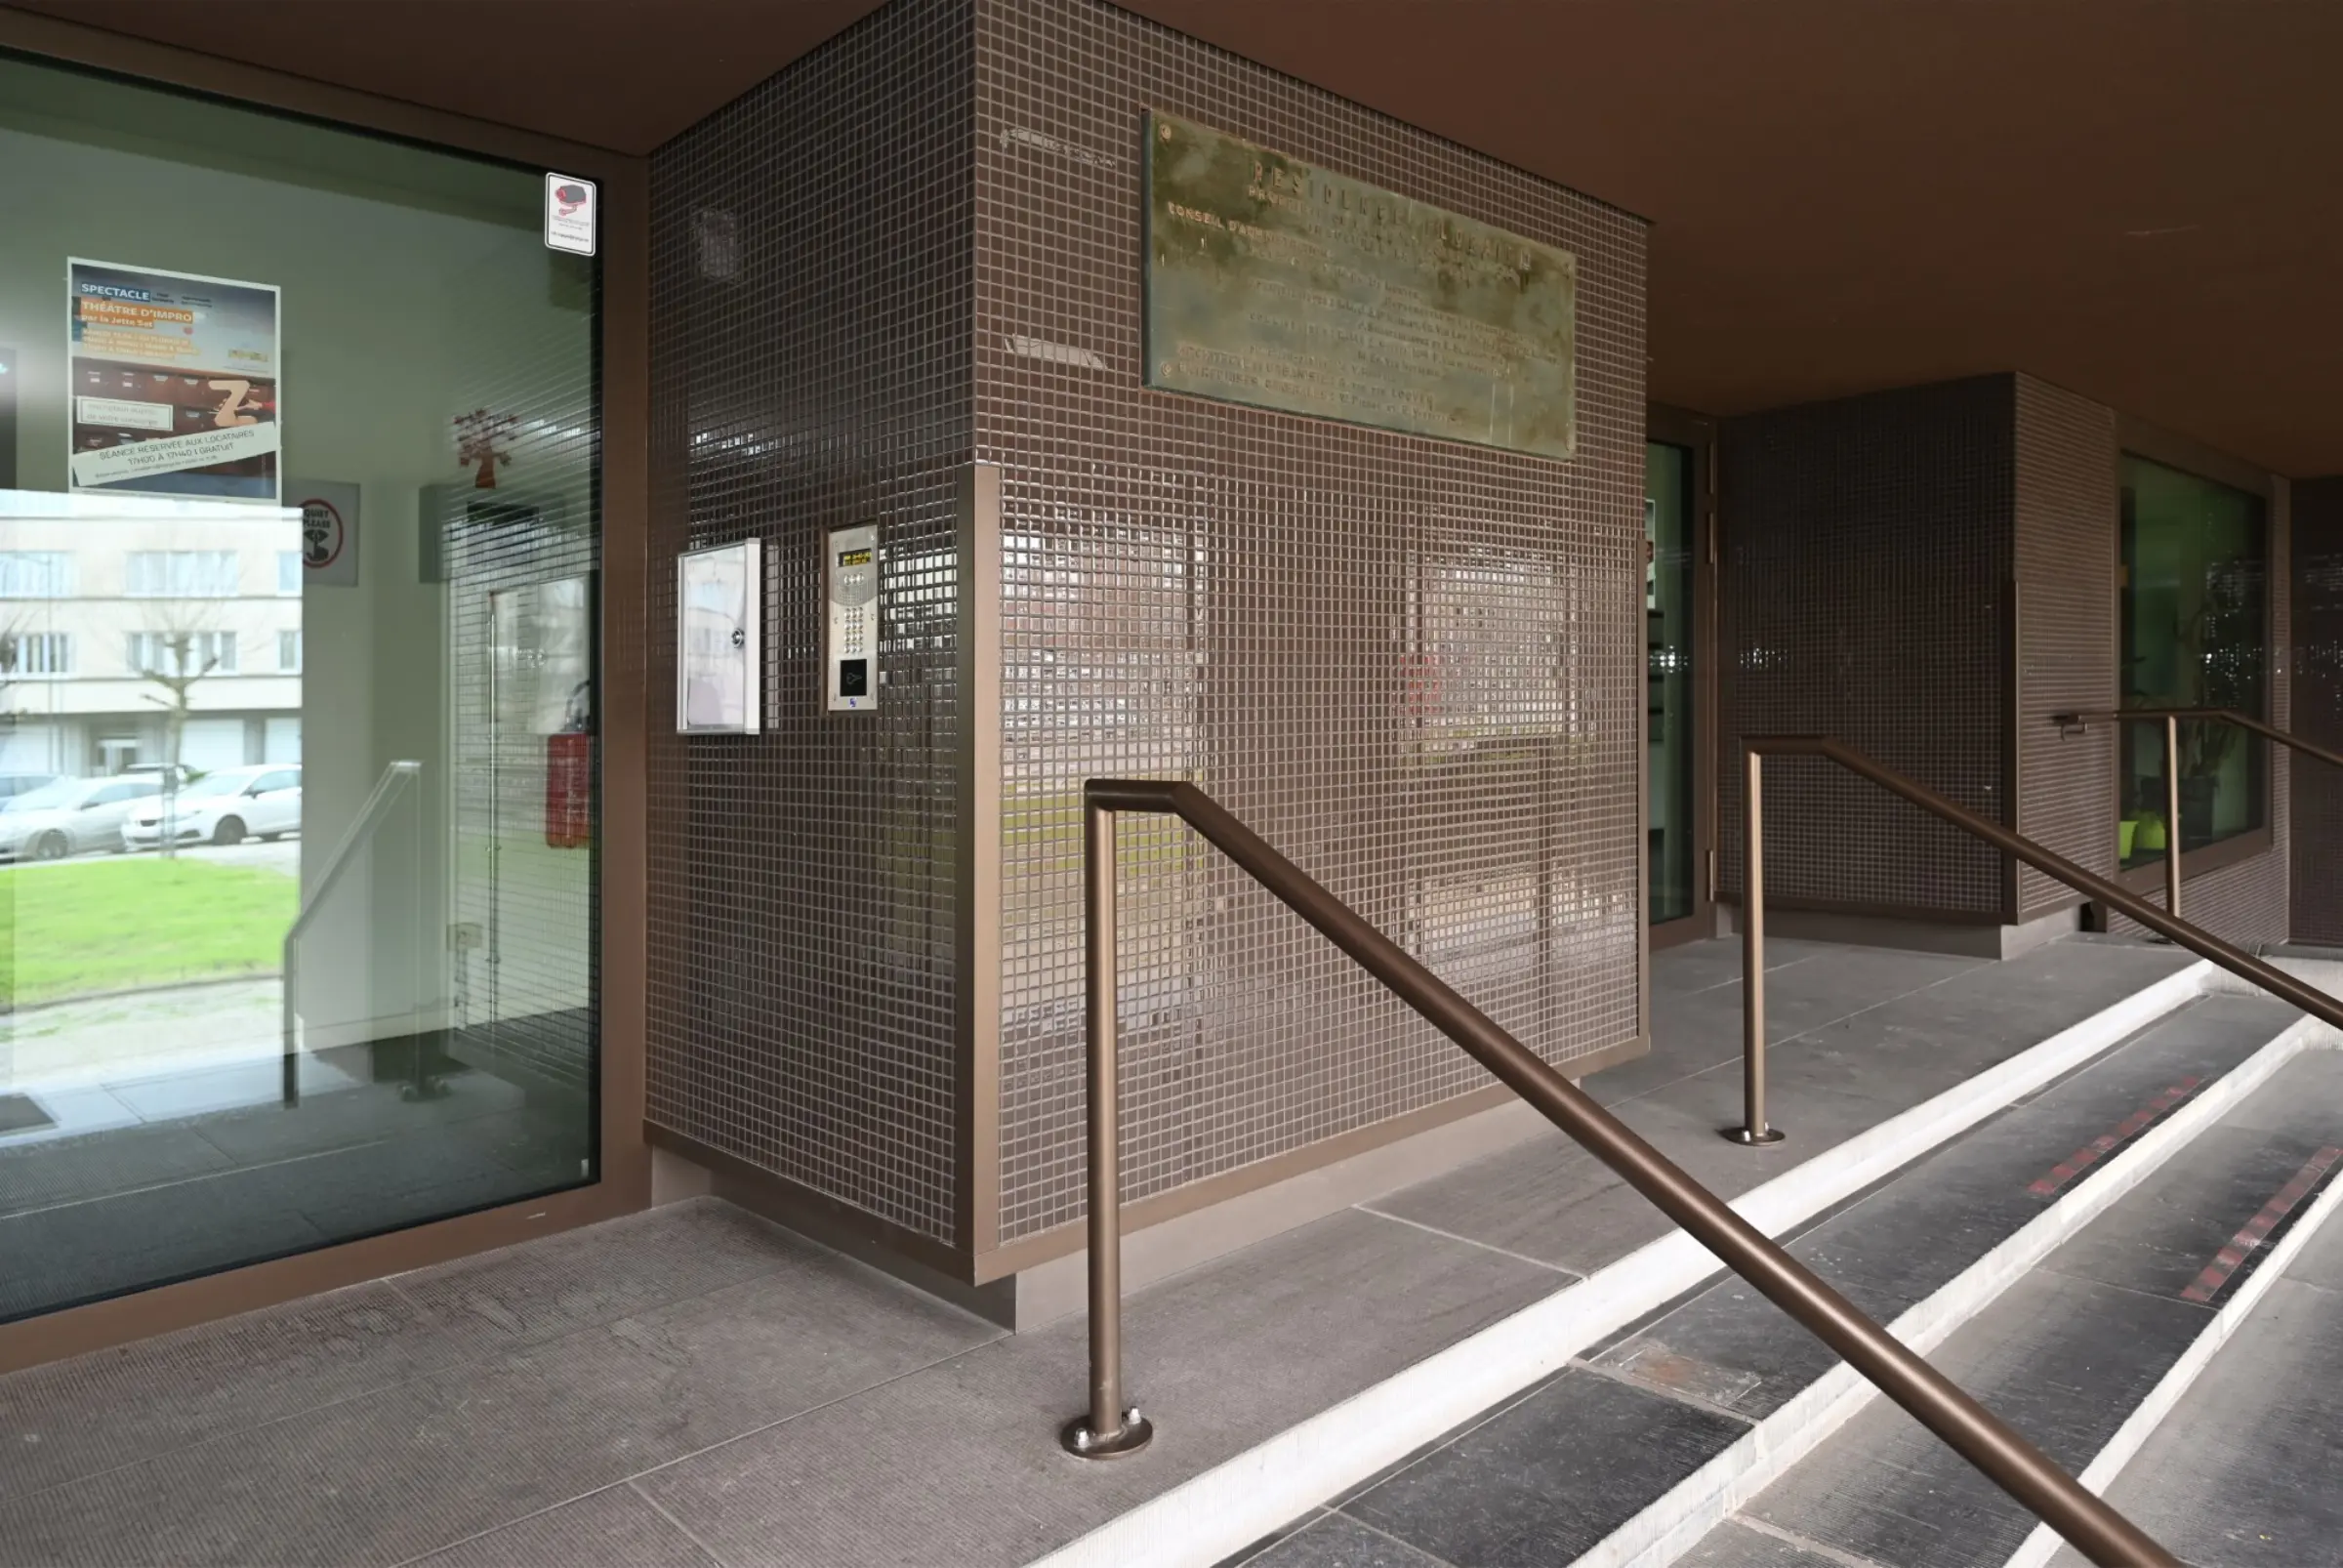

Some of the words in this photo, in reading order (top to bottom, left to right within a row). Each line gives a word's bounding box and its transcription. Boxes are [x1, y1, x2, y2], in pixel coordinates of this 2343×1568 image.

[81, 283, 150, 301] SPECTACLE
[141, 308, 192, 322] D'IMPRO
[185, 437, 203, 448] AUX
[205, 430, 255, 444] LOCATAIRES
[199, 442, 235, 455] GRATUIT
